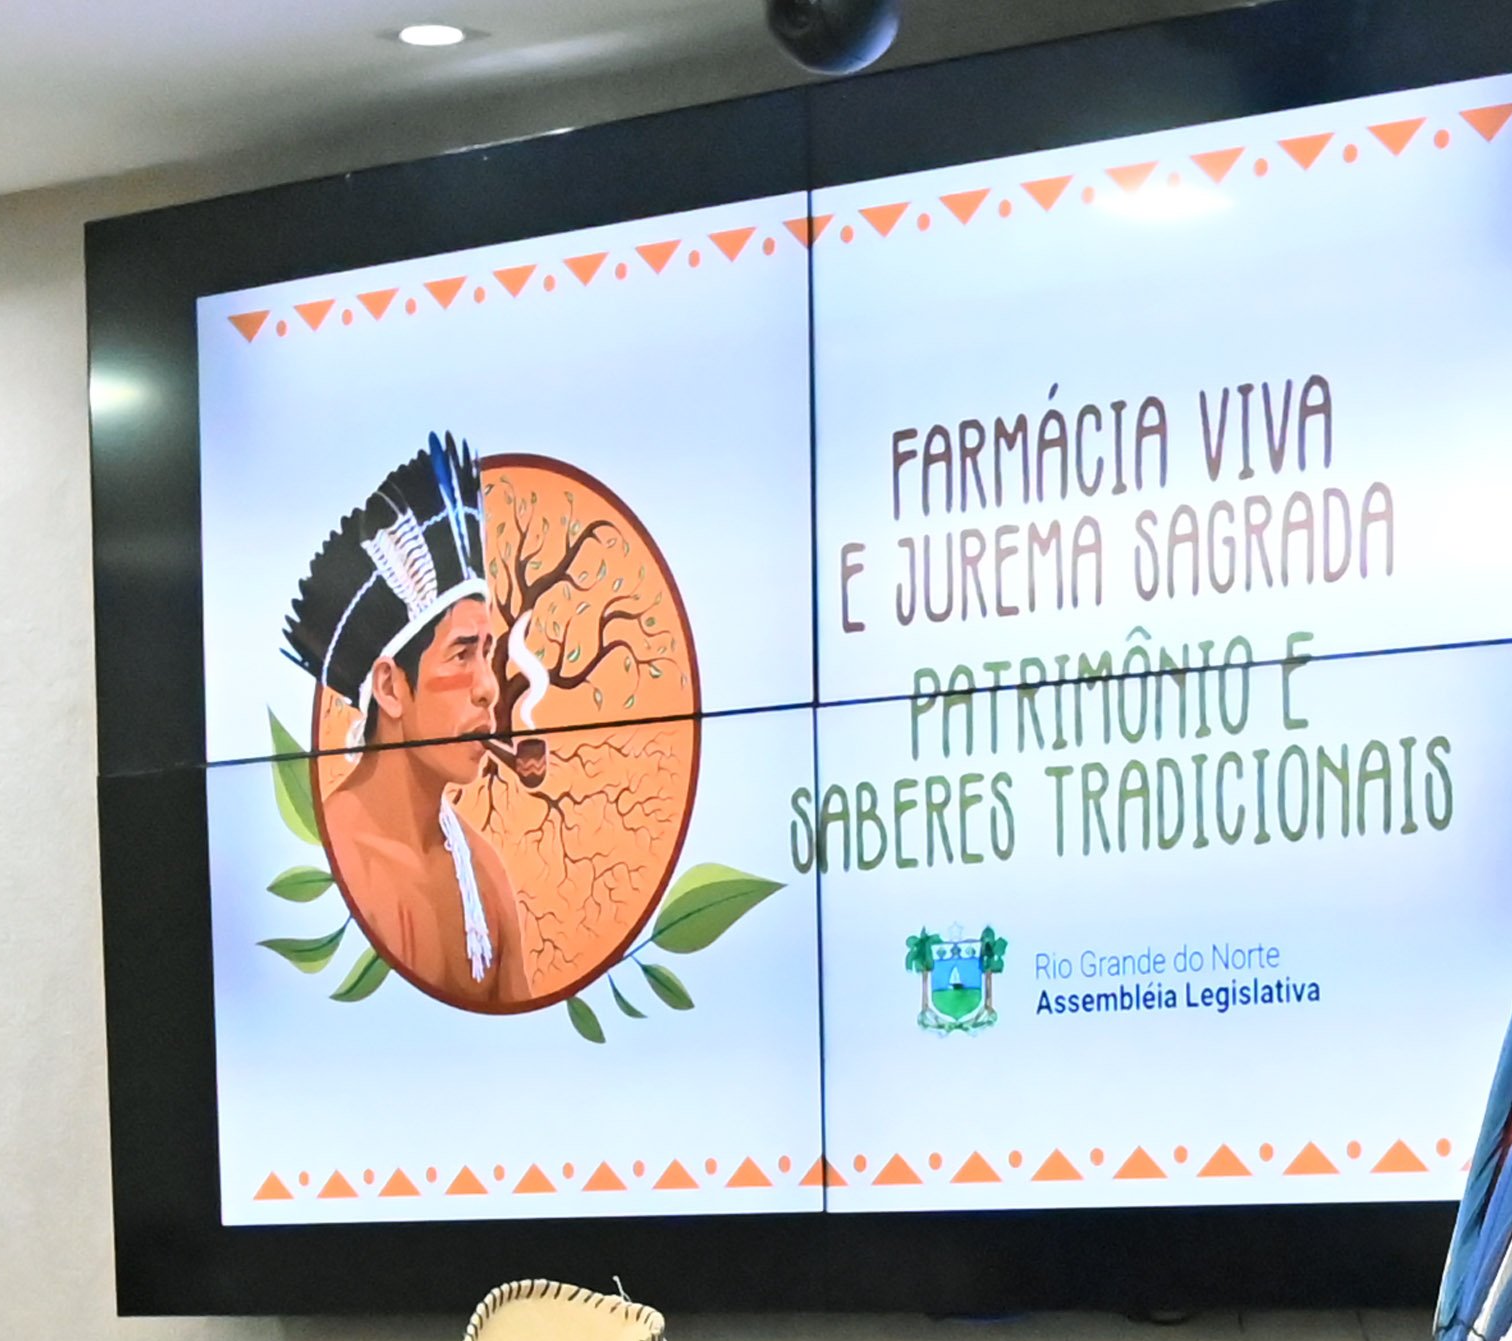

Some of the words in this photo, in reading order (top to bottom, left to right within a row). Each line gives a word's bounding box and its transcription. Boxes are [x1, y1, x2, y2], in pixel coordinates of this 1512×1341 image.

[892, 383, 1168, 521] FARMÁCIA
[1199, 373, 1333, 482] VIVA
[840, 542, 866, 634] E
[895, 514, 1103, 627] JUREMA
[1134, 481, 1394, 602] SAGRADA
[909, 625, 1254, 761] PATRIMÔNIO
[1281, 631, 1315, 730] E
[790, 771, 1015, 875] SABERES
[1044, 736, 1454, 858] TRADICIONAIS
[1035, 952, 1072, 980] Rio
[1080, 945, 1166, 978] Grande
[1173, 943, 1202, 974] do
[1212, 941, 1280, 971] Norte
[1036, 979, 1177, 1015] Assembléia
[1186, 976, 1321, 1013] Legislativa
